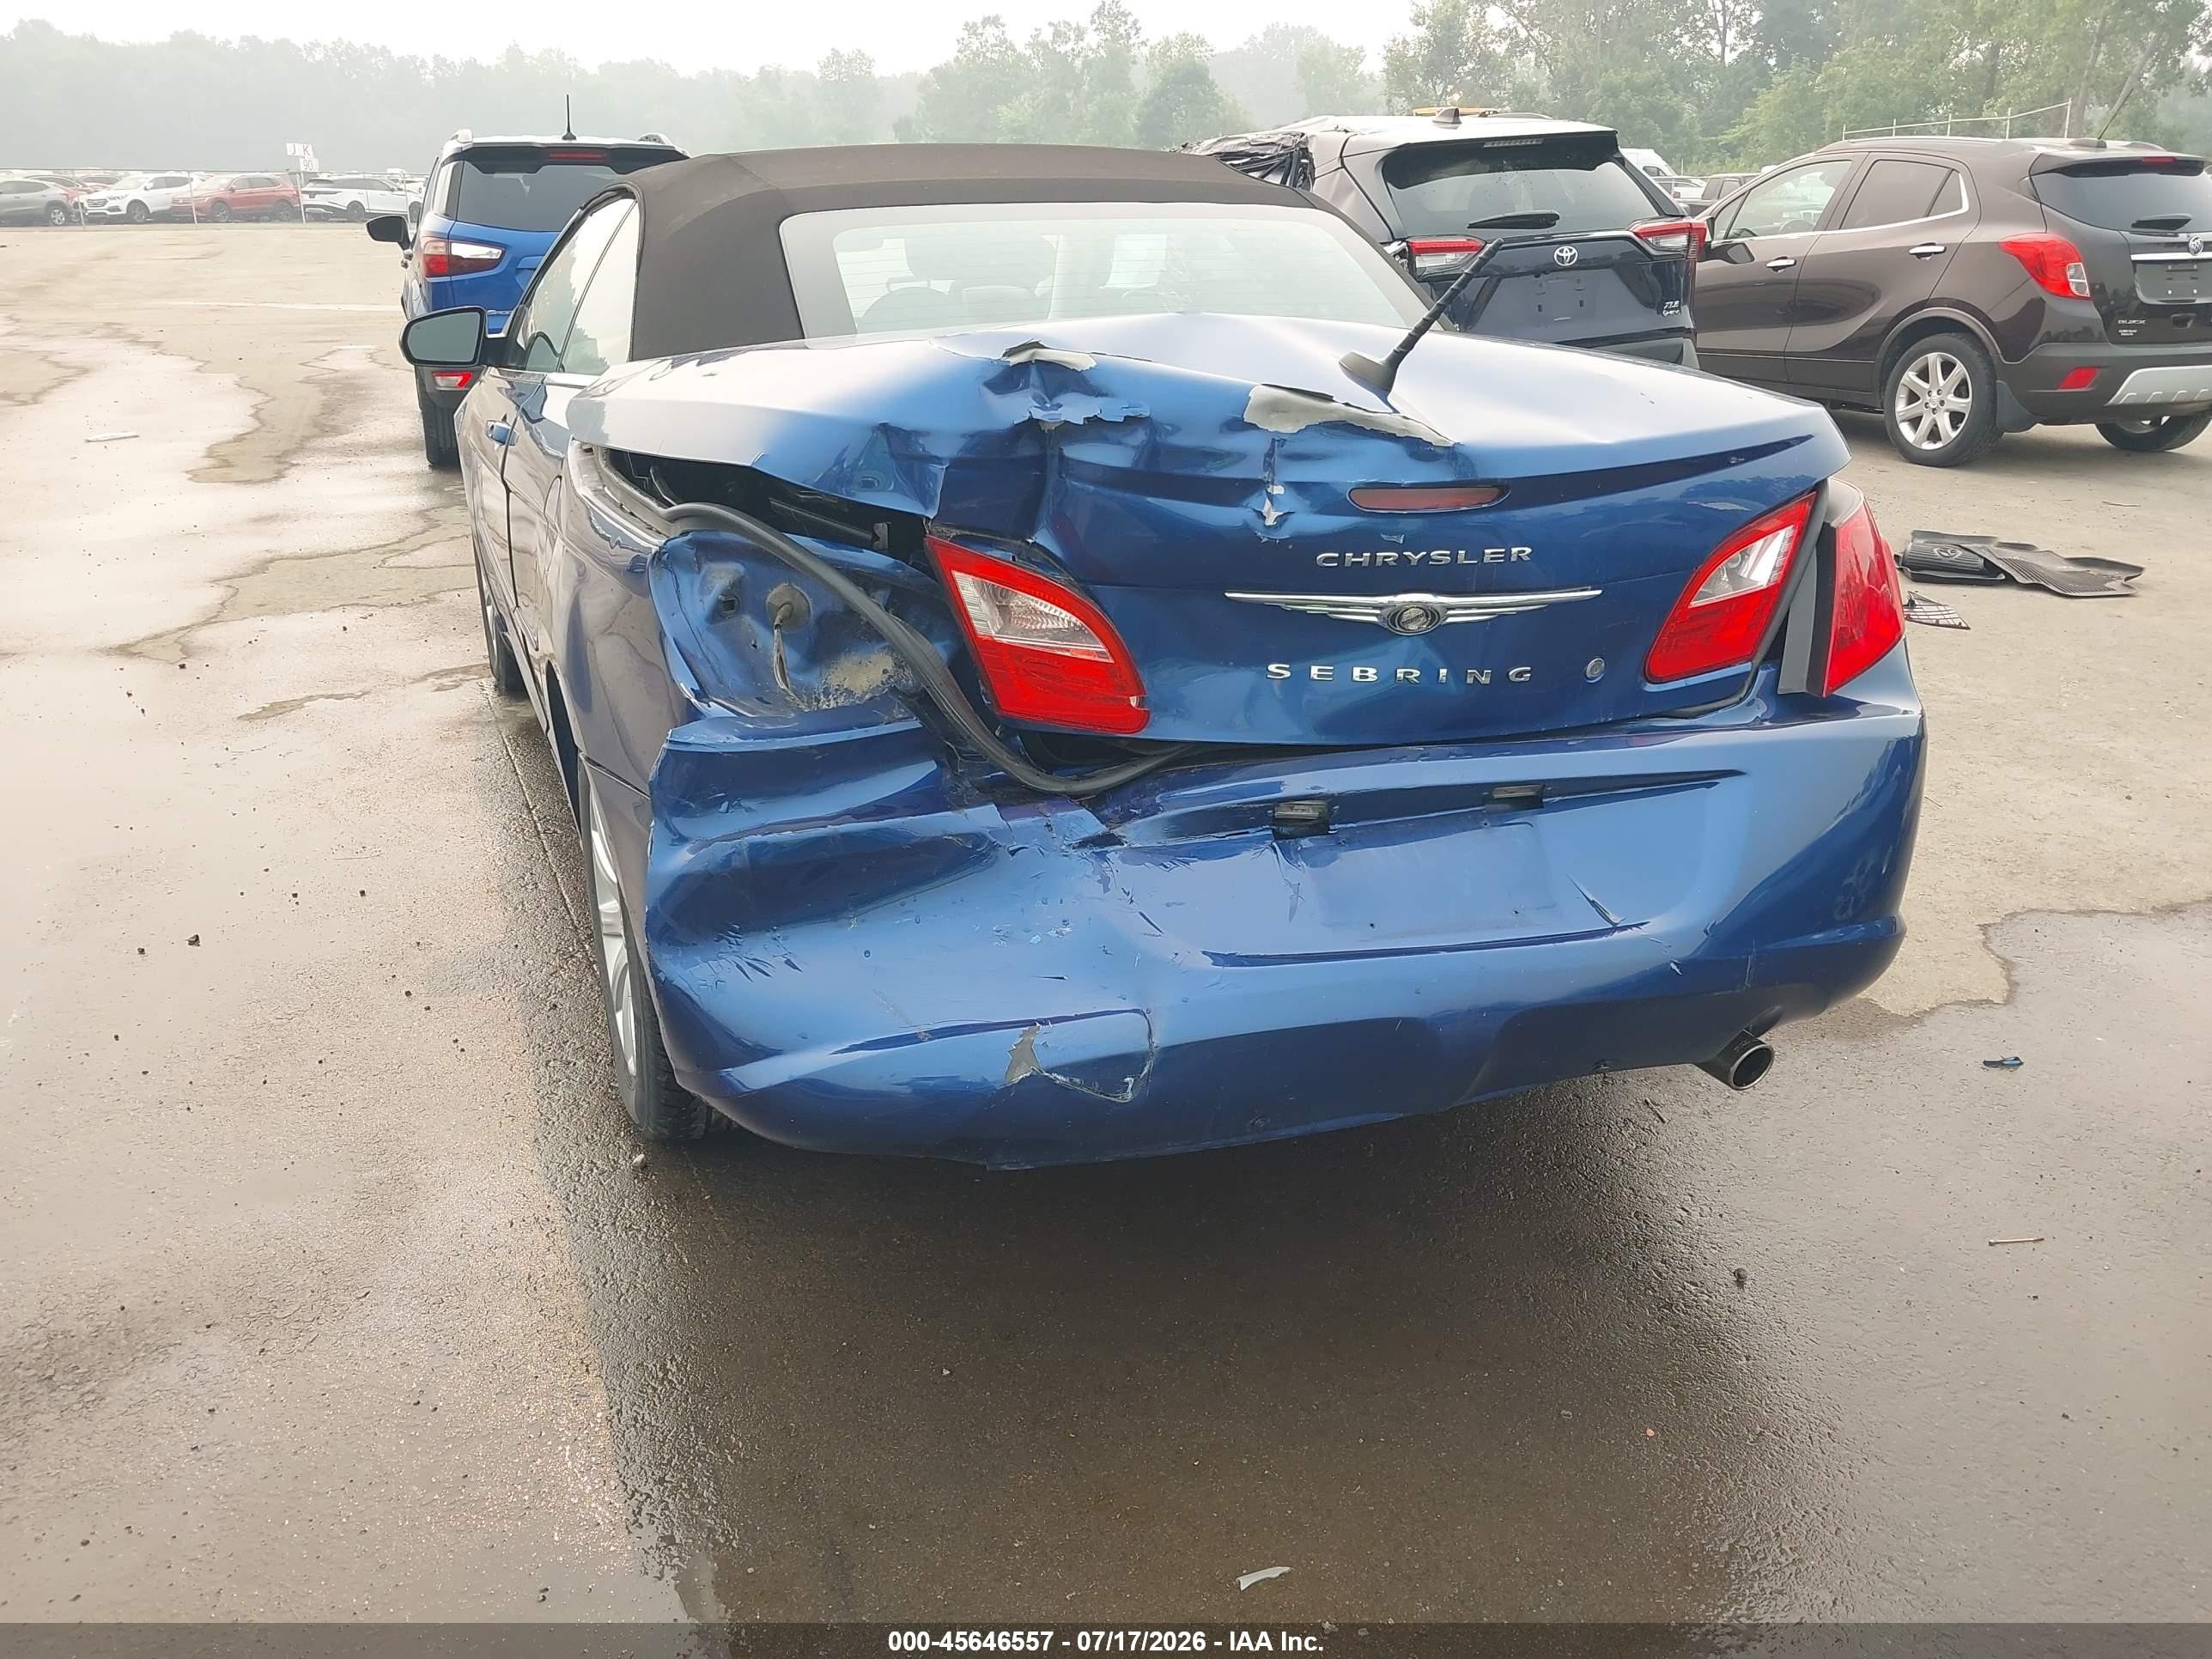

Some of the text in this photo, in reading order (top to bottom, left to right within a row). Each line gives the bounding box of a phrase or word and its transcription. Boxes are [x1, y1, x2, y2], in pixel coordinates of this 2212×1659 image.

[302, 143, 310, 155] K
[1316, 546, 1533, 568] CHRYSLER
[1266, 663, 1532, 684] SEBRING
